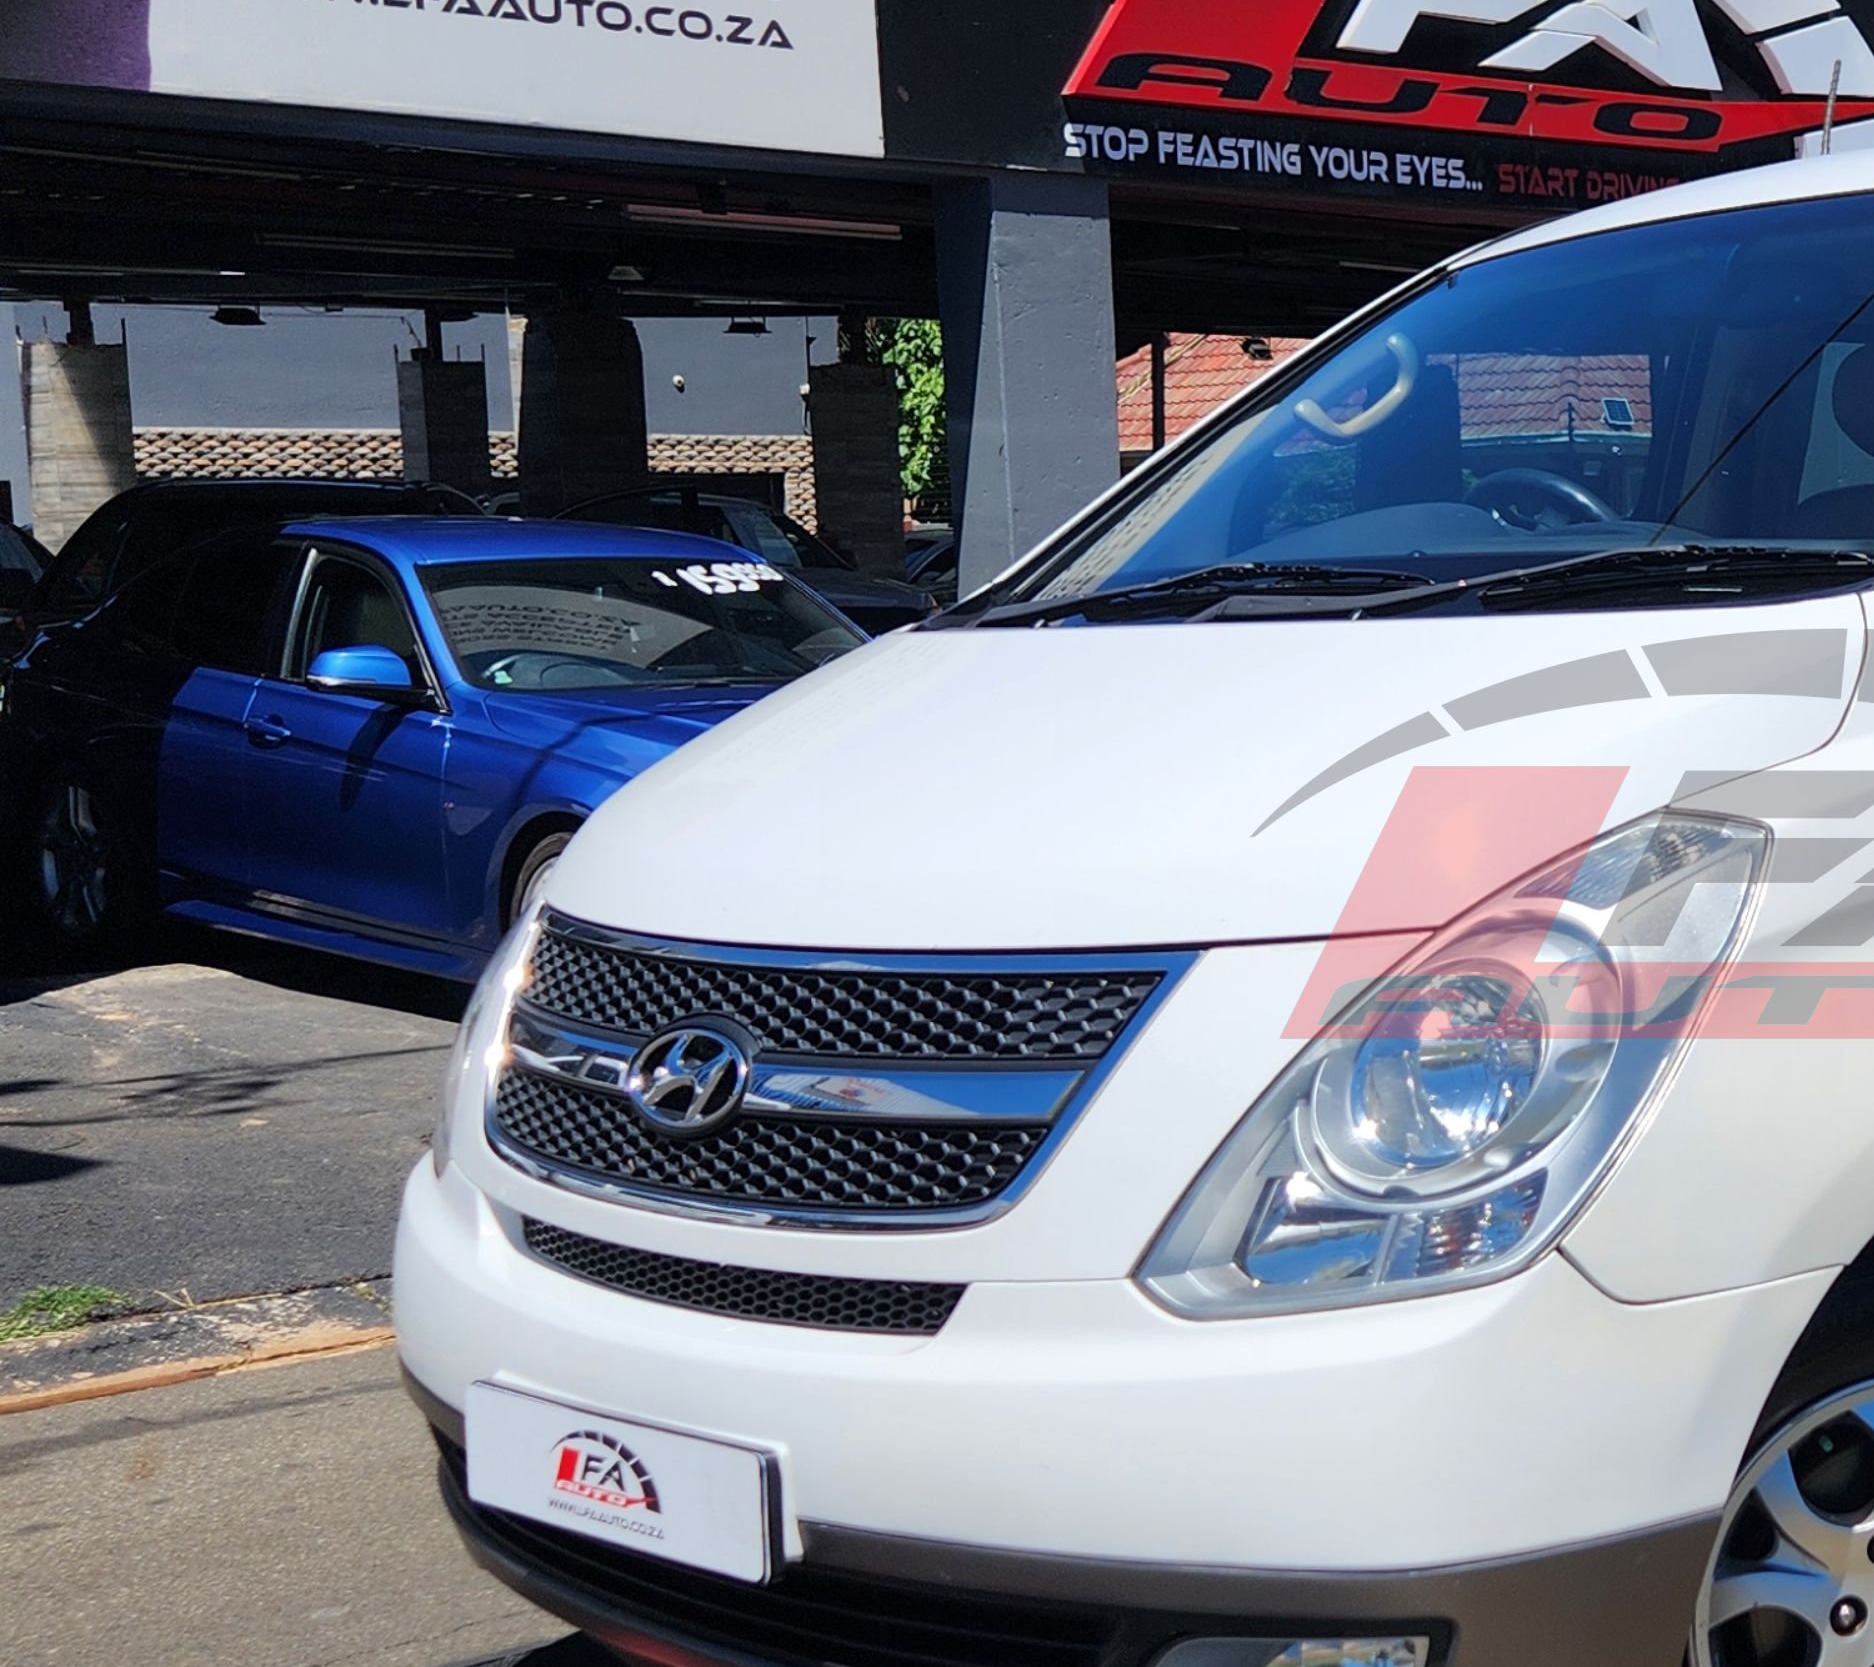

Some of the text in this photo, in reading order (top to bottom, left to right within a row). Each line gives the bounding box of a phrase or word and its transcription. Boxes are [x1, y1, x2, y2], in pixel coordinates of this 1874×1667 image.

[1096, 52, 1723, 141] AUTO
[1064, 122, 1149, 162] STOP
[1157, 131, 1301, 176] FEASTING
[1308, 145, 1389, 183] YOUR
[1396, 153, 1483, 191] EYES...
[1499, 163, 1579, 198] START
[556, 1480, 628, 1508] AUTO
